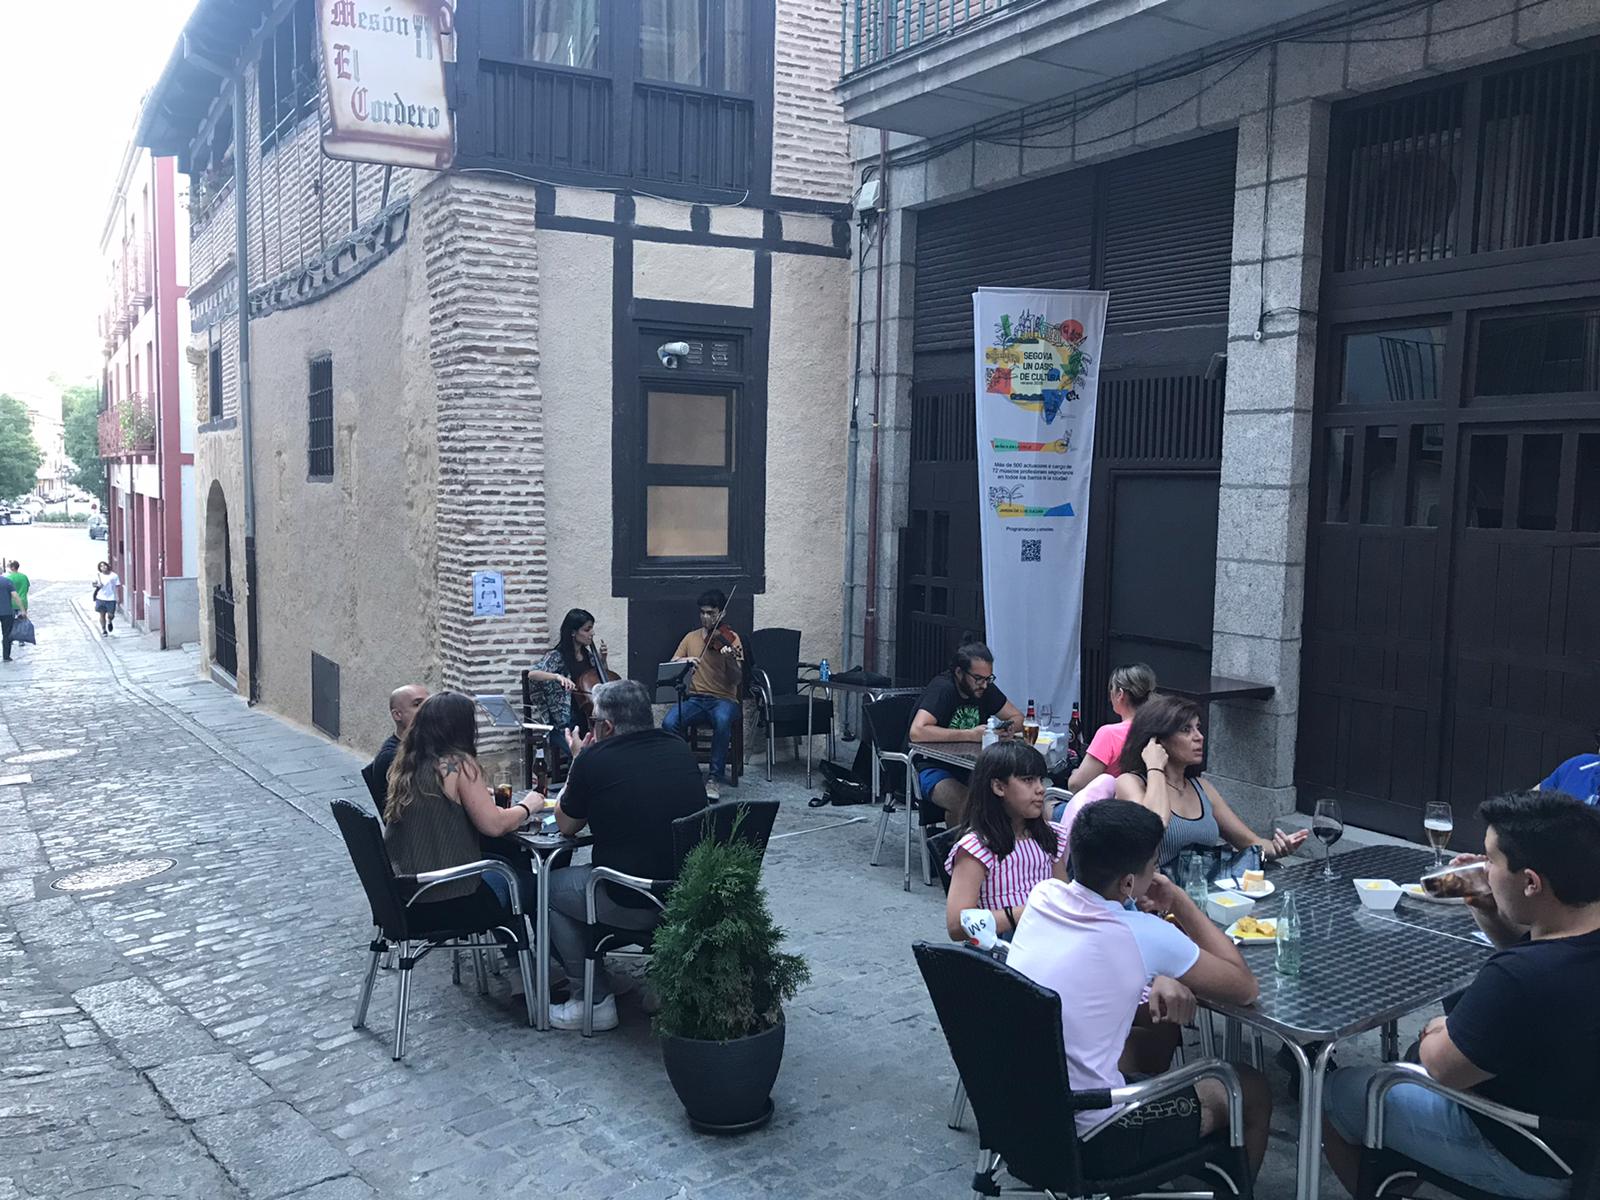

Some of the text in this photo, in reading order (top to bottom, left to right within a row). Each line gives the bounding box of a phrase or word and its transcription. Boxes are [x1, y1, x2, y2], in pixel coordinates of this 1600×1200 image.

[331, 0, 408, 35] Mesón
[333, 43, 360, 82] El
[351, 86, 440, 129] Cordero
[1023, 351, 1053, 360] SEGOVIA
[1023, 362, 1033, 370] UN
[1020, 372, 1030, 381] DE
